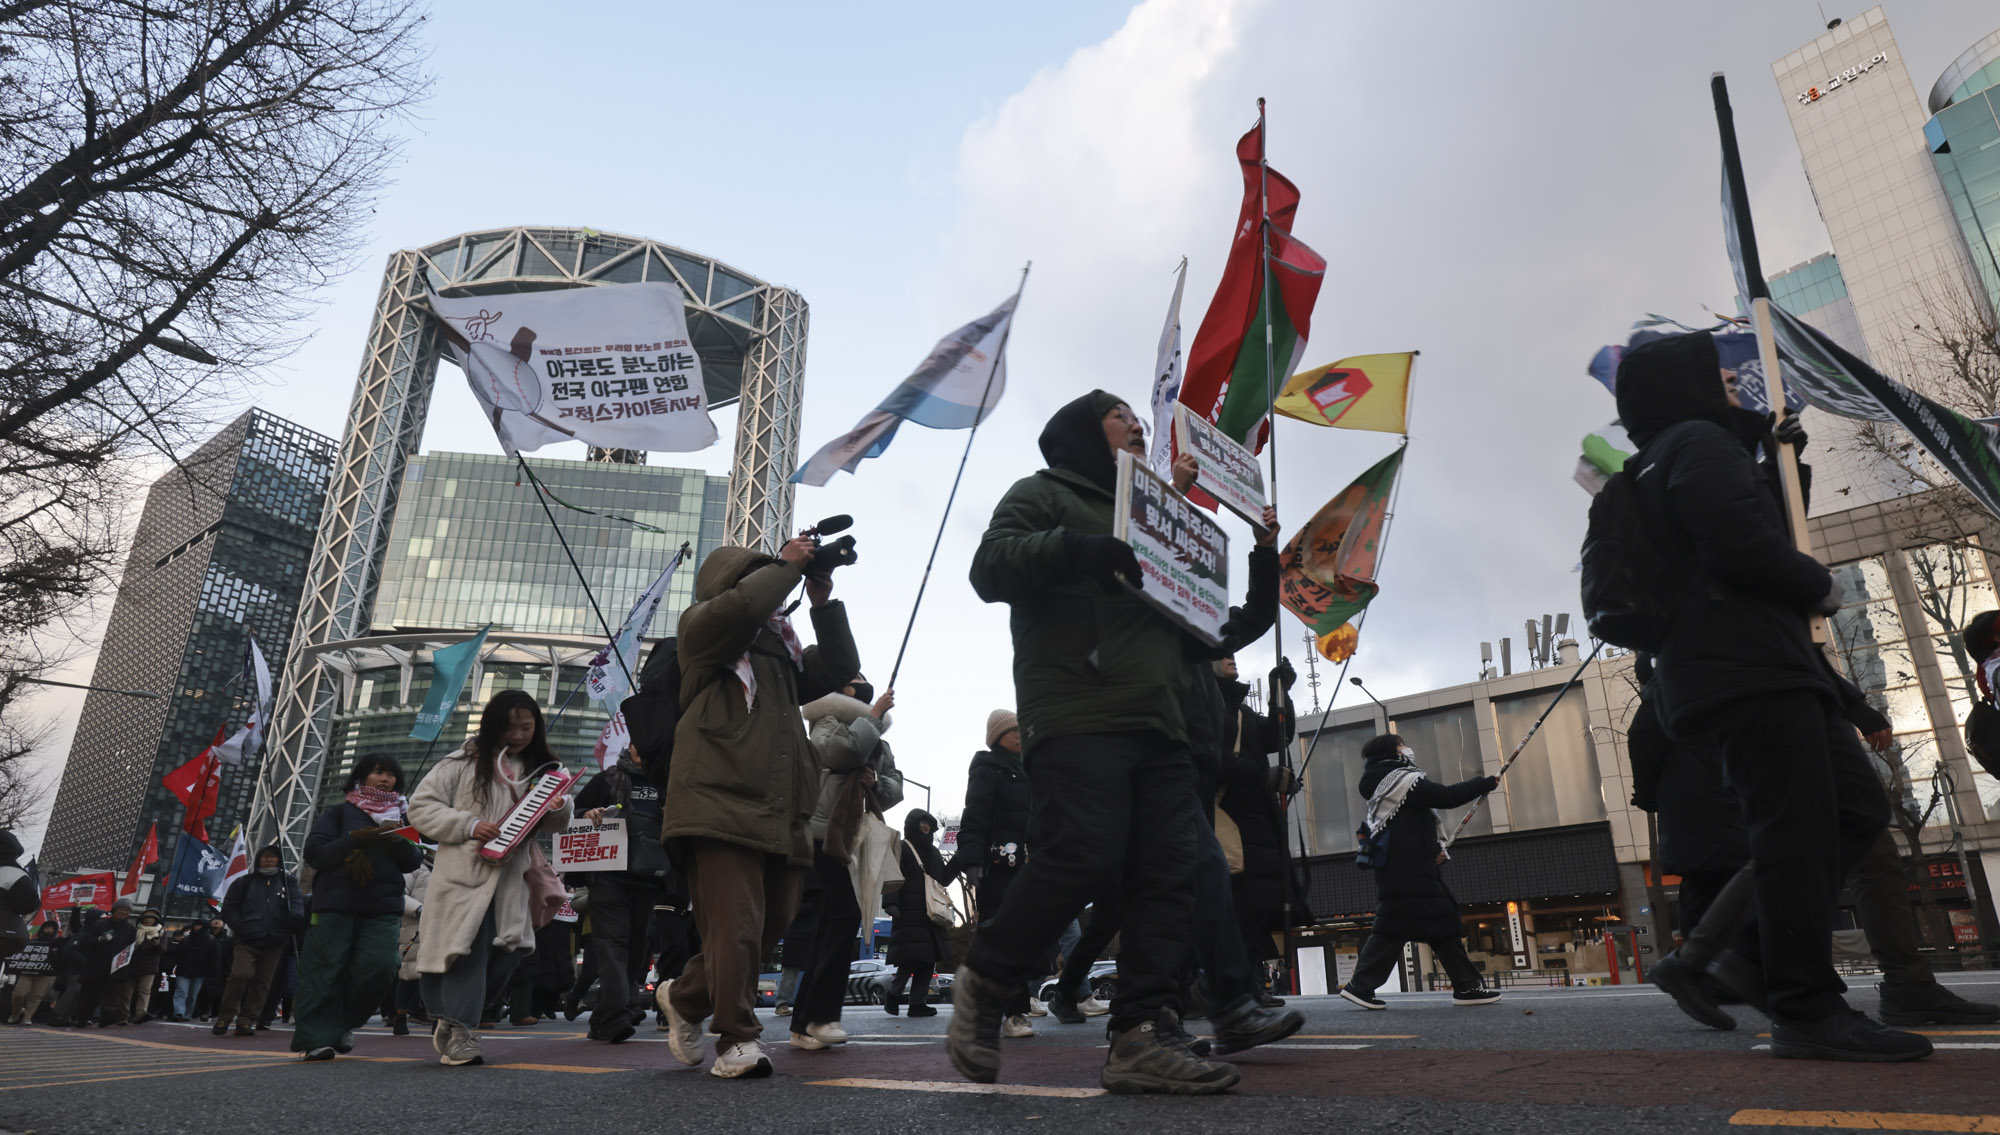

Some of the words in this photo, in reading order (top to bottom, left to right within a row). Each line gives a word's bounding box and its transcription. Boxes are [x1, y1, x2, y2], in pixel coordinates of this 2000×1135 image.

[1828, 51, 1888, 91] 교원투어
[546, 357, 616, 378] 야구로도
[621, 352, 694, 375] 분노하는
[551, 381, 586, 401] 전국
[591, 377, 649, 398] 야구팬
[653, 374, 689, 394] 연합
[1134, 468, 1162, 506] 미국
[1164, 491, 1226, 558] 제국주의에
[1145, 503, 1172, 542] 맞서
[1174, 526, 1217, 575] 싸우자!
[560, 832, 601, 849] 미국을
[560, 844, 619, 864] 규탄한다!
